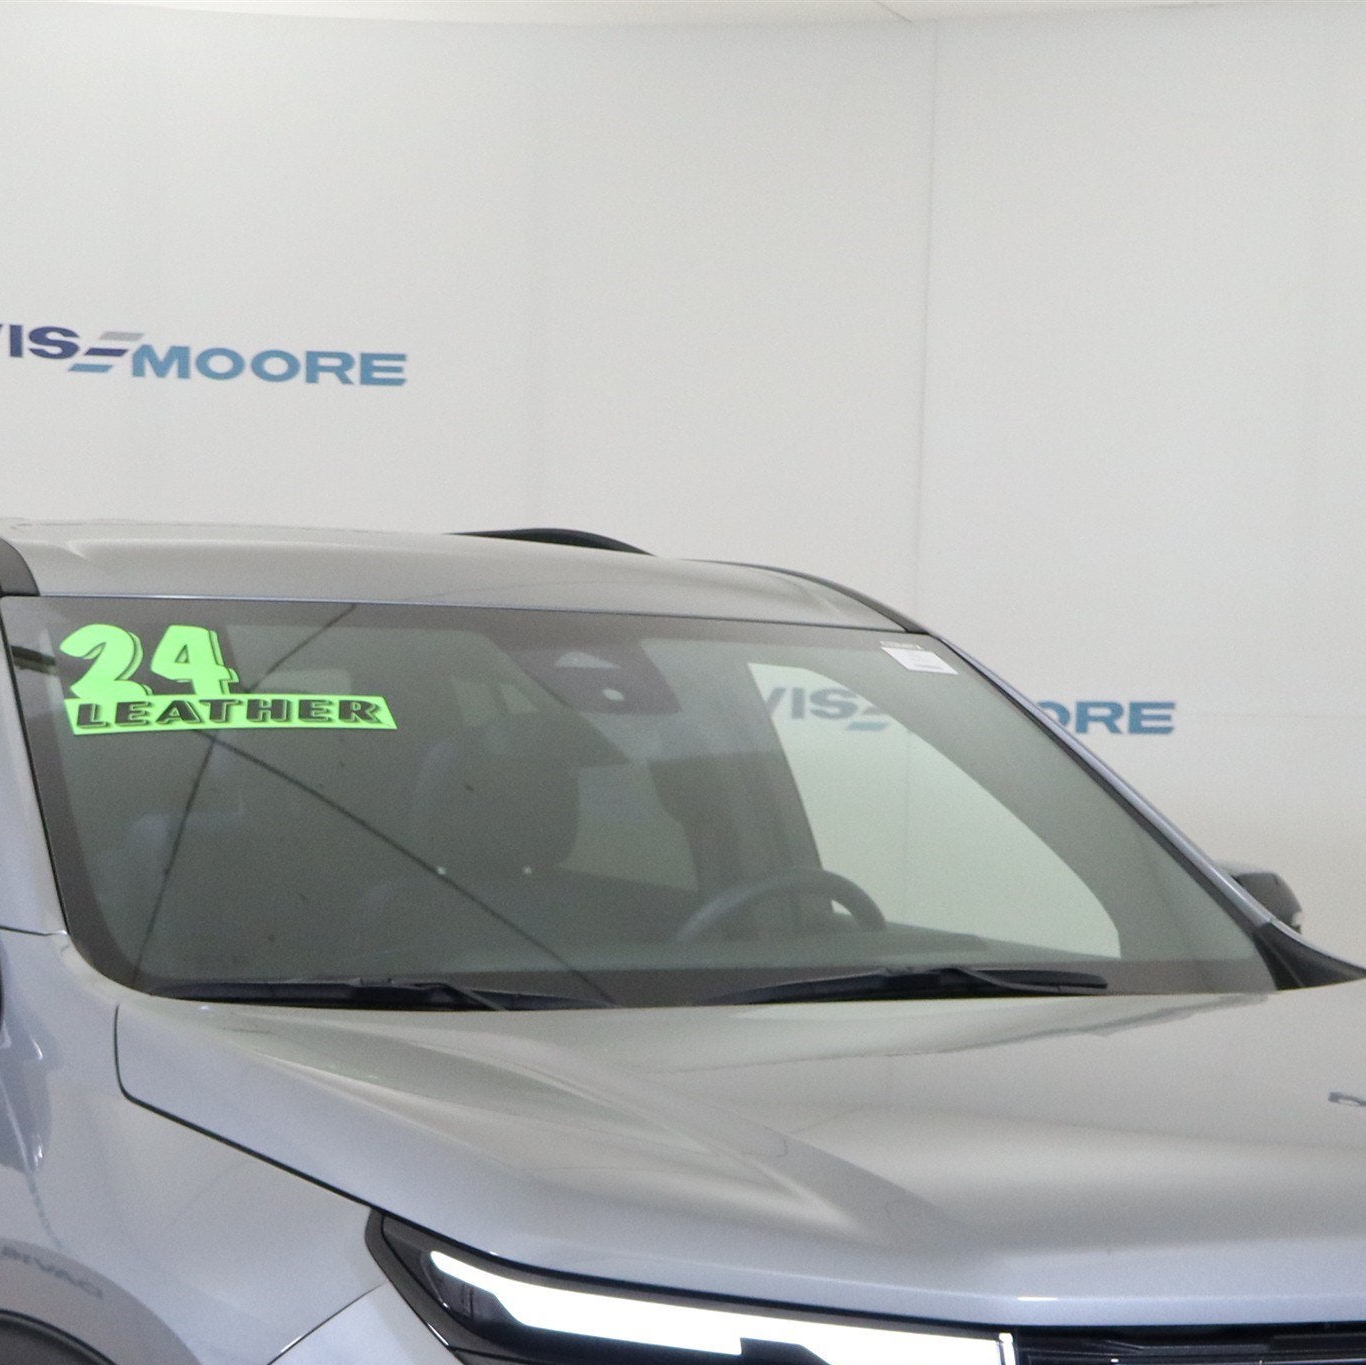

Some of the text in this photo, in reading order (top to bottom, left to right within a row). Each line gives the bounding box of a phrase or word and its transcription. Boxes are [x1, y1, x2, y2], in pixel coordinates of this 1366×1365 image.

[131, 343, 408, 387] MOORE
[60, 624, 238, 698] 24
[75, 698, 385, 728] LEATHER
